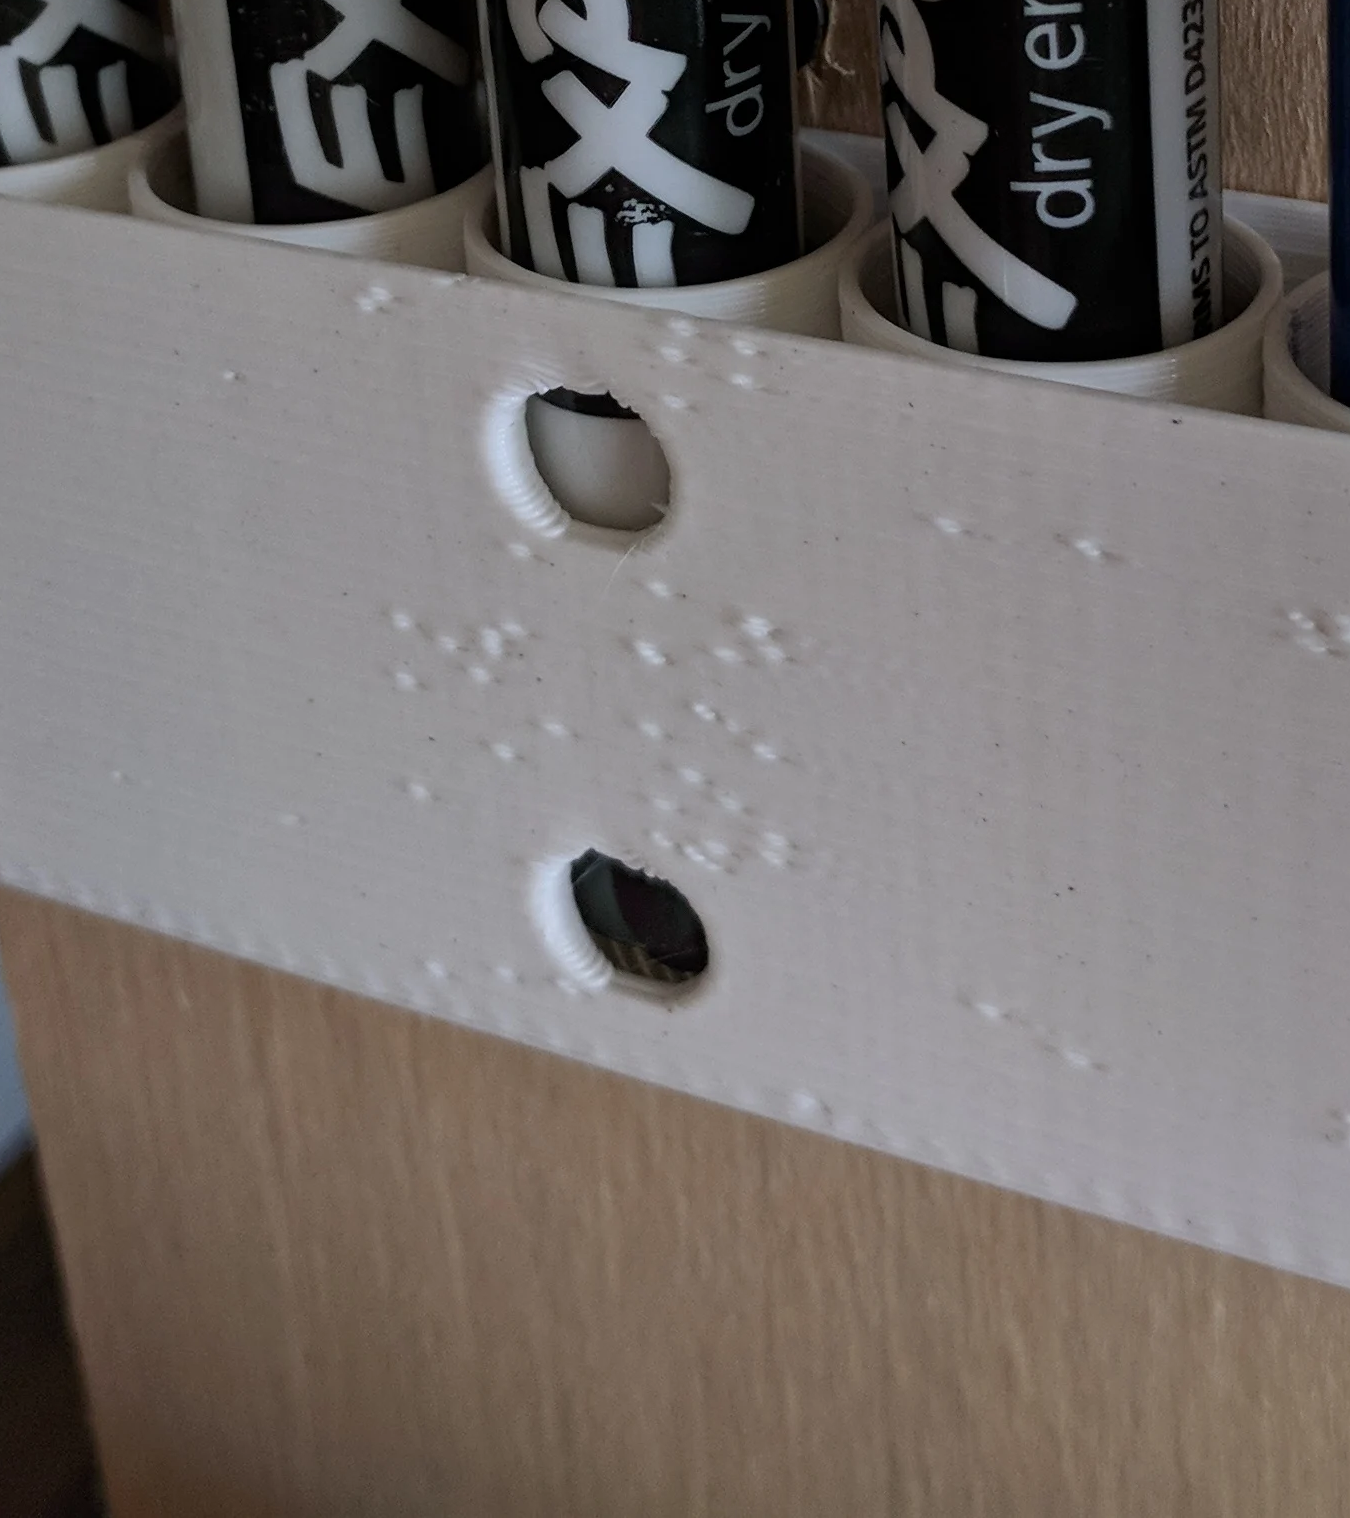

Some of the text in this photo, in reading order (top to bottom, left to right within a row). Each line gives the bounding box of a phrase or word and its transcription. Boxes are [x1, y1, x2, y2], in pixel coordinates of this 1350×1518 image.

[705, 13, 772, 138] dry
[1009, 89, 1114, 230] dry
[1184, 95, 1209, 209] ASTM
[1189, 212, 1210, 255] TO
